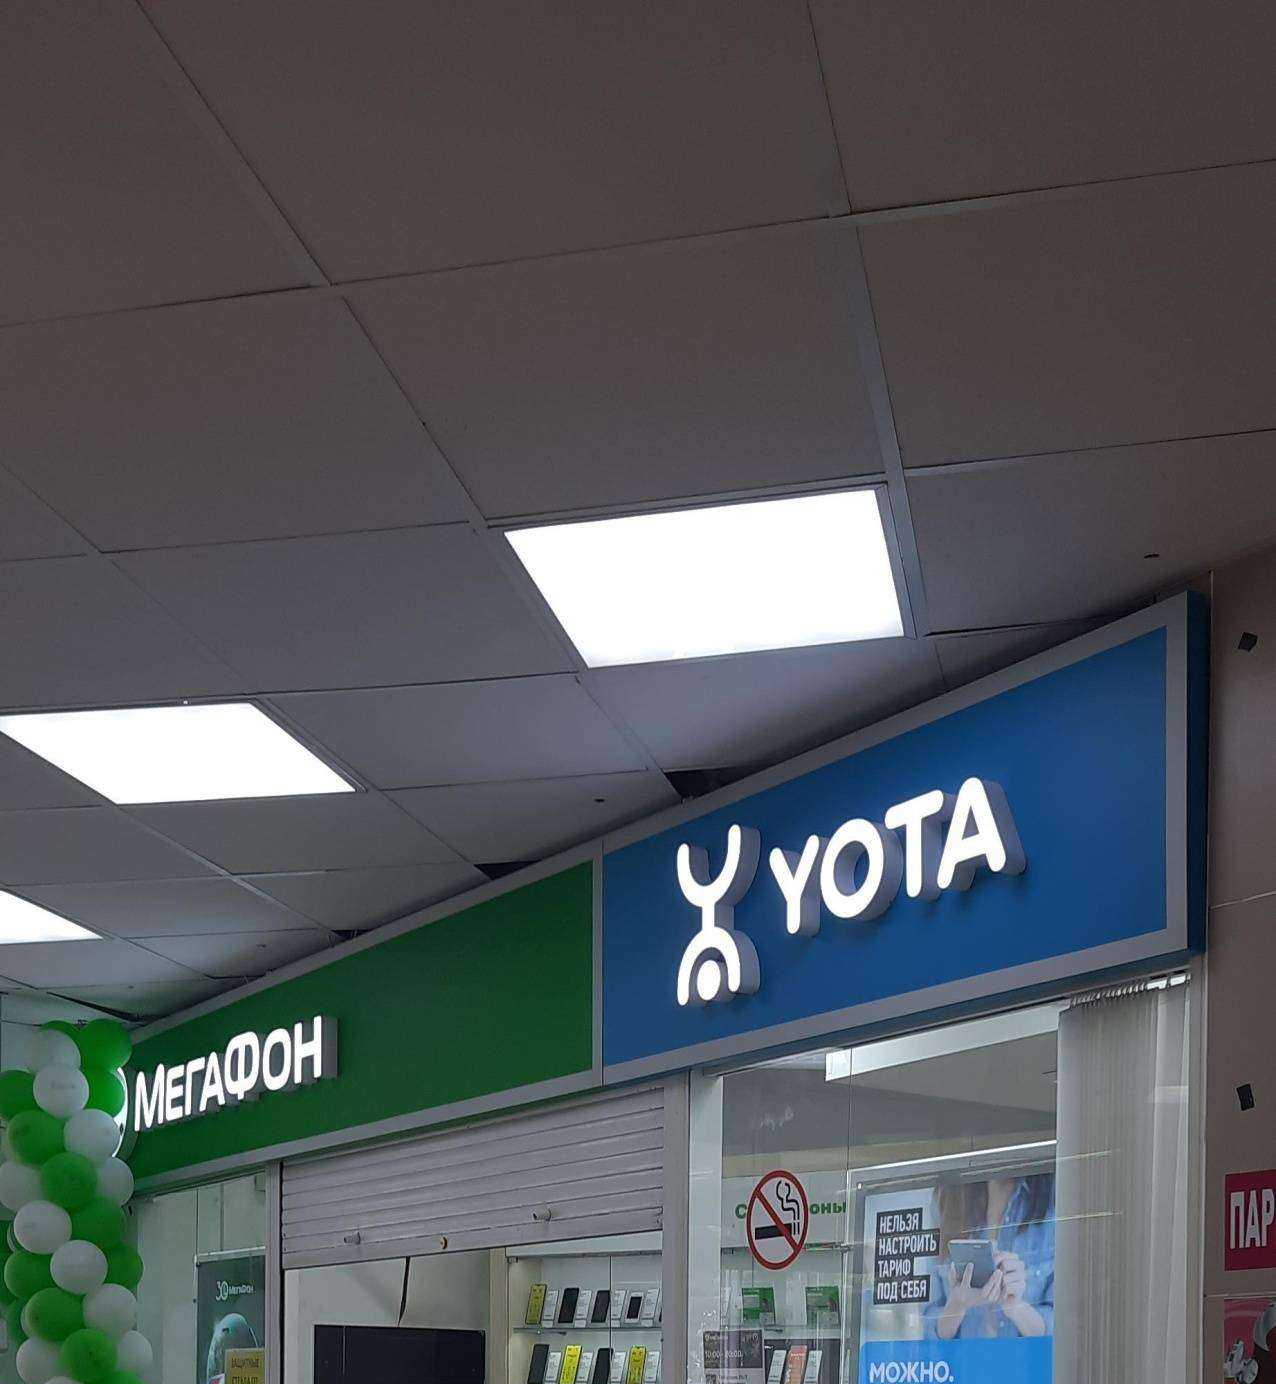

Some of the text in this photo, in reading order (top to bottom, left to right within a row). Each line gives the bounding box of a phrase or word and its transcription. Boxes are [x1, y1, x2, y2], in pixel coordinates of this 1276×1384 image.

[769, 777, 1007, 934] YOTA
[880, 1213, 919, 1233] НЕЛЬЗЯ
[878, 1234, 937, 1255] НАСТРОИТЬ
[877, 1258, 911, 1277] ТАРИФ
[877, 1280, 927, 1301] ПОД СЕБЯ
[869, 1361, 954, 1383] МОЖНО.
